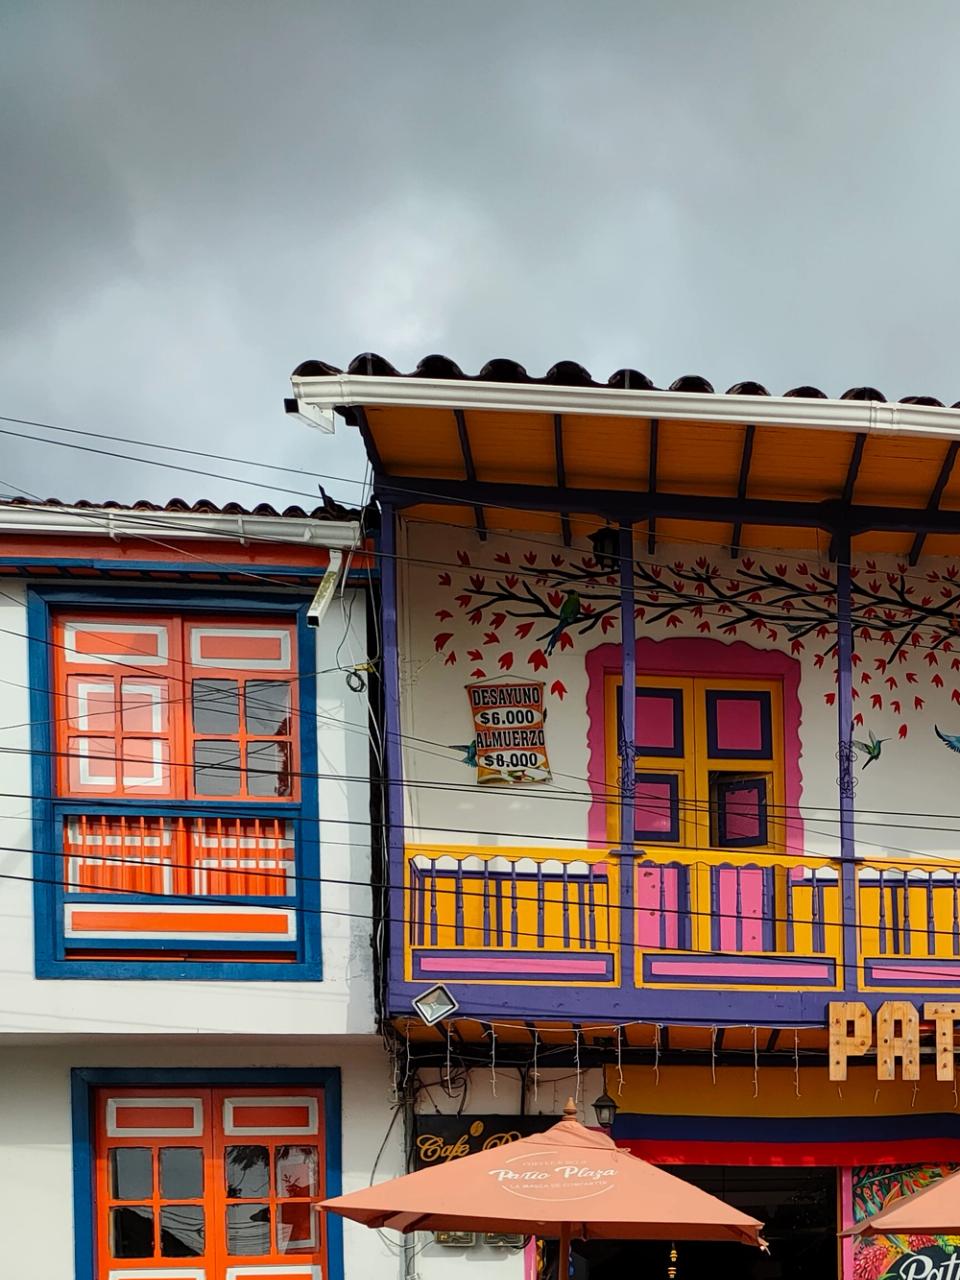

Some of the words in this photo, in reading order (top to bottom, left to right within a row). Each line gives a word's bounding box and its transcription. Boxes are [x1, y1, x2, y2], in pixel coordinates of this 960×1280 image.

[472, 687, 540, 706] DESAYUNO
[480, 709, 534, 725] $6.000
[476, 730, 545, 748] ALMUERZO
[484, 752, 537, 768] $8.000
[488, 1169, 551, 1181] Patio
[554, 1165, 618, 1180] Plaza
